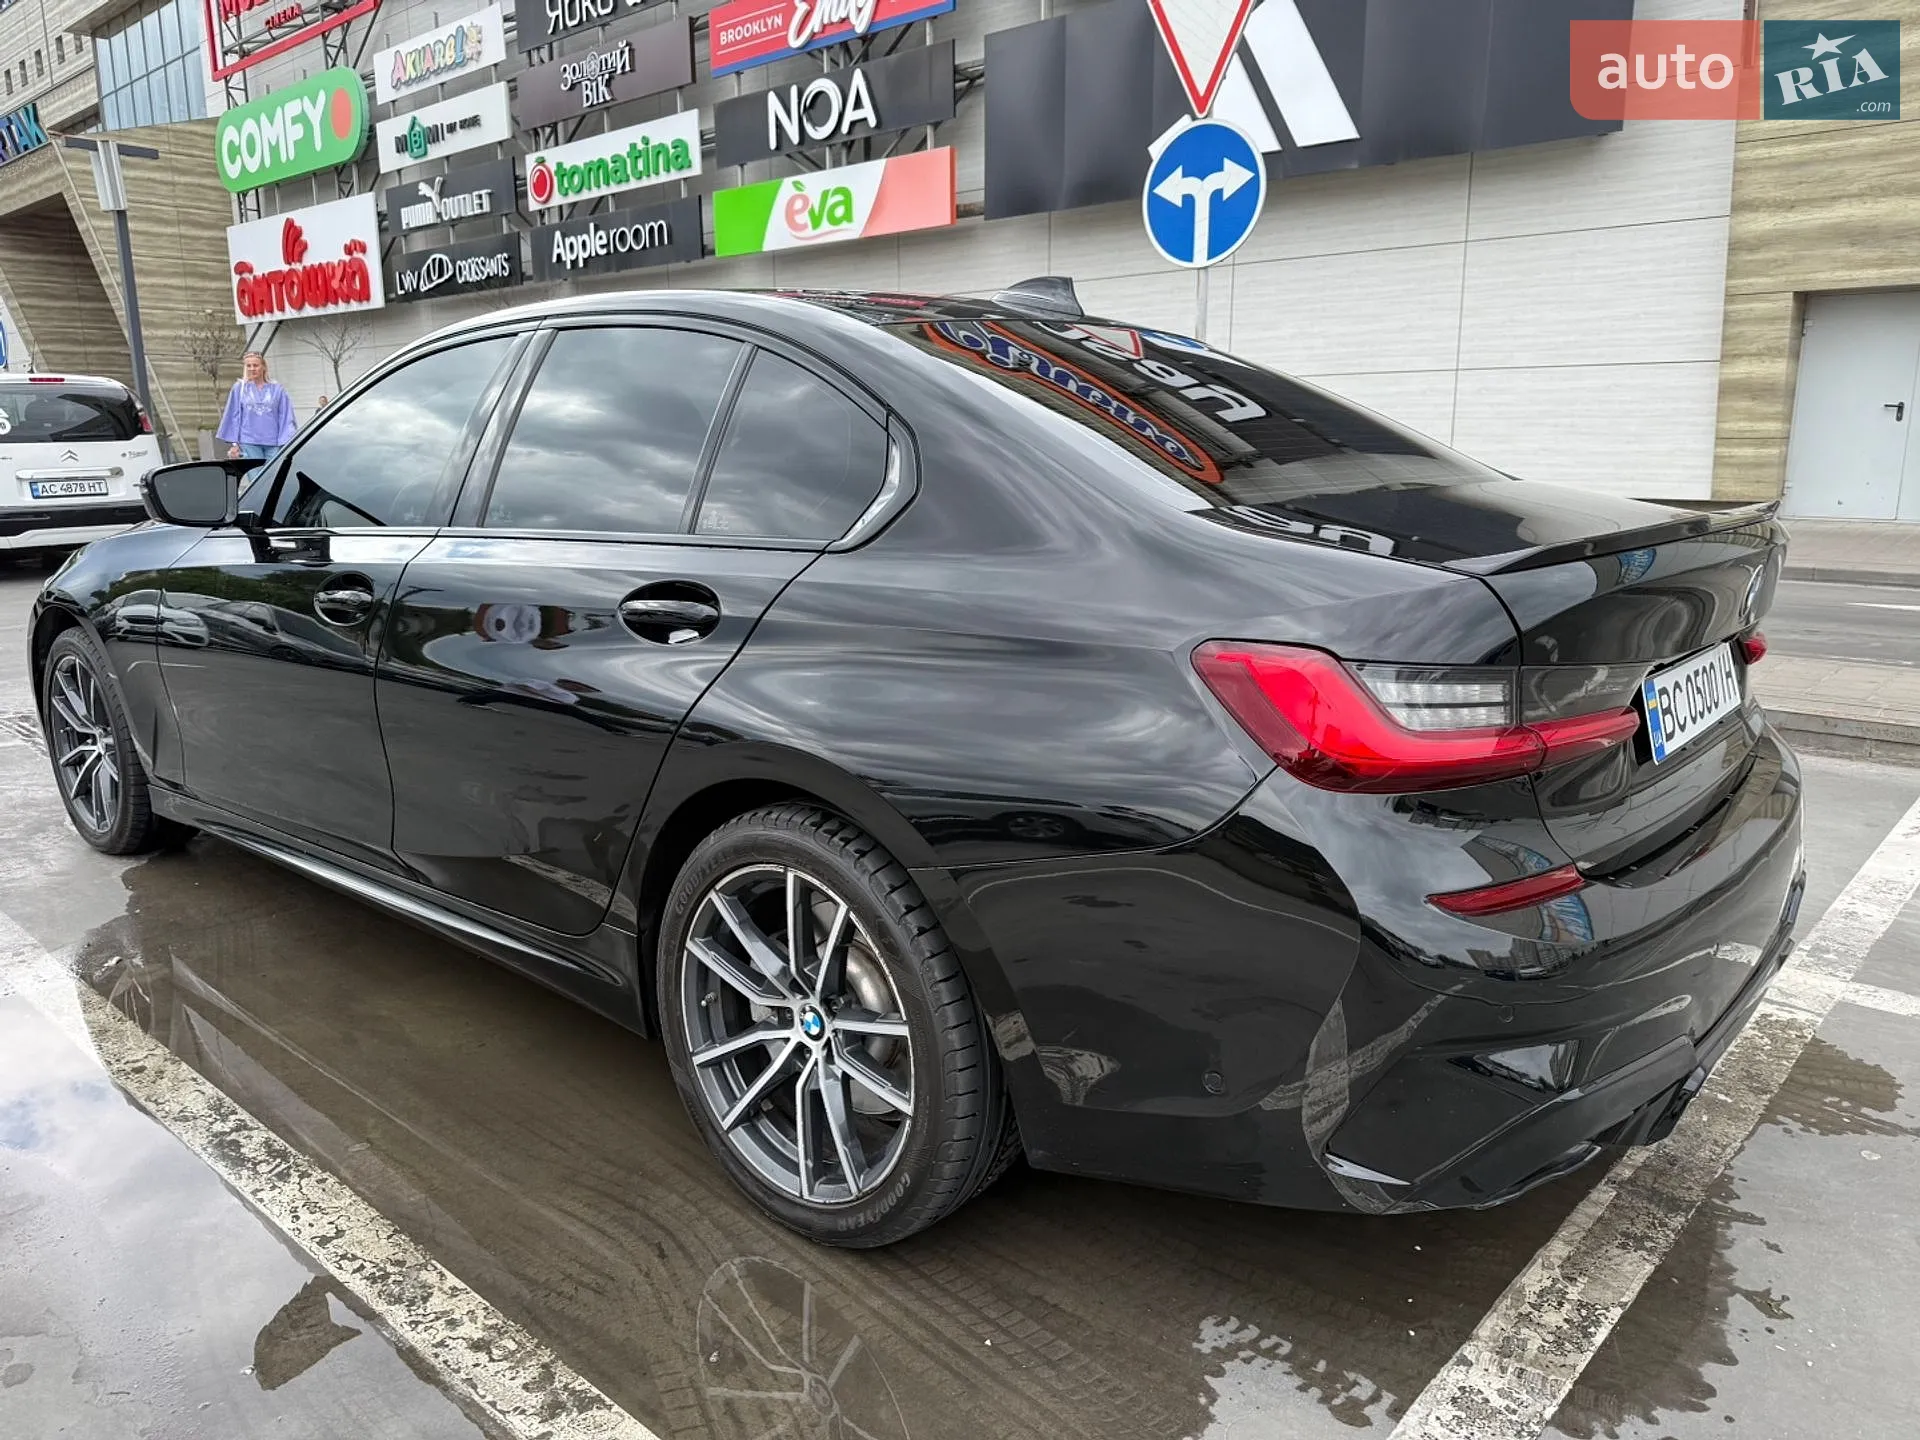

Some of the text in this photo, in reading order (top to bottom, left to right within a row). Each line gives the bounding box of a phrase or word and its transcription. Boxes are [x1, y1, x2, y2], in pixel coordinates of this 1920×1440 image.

[719, 13, 783, 46] BROOKLYN
[767, 68, 878, 151] NOA
[221, 88, 327, 180] COMFY
[553, 134, 693, 197] tomatina
[440, 188, 493, 221] OUTLET
[455, 252, 510, 284] CROISSANTS
[41, 481, 104, 495] AC 4878 HT
[1657, 648, 1738, 743] BC 0500 IH
